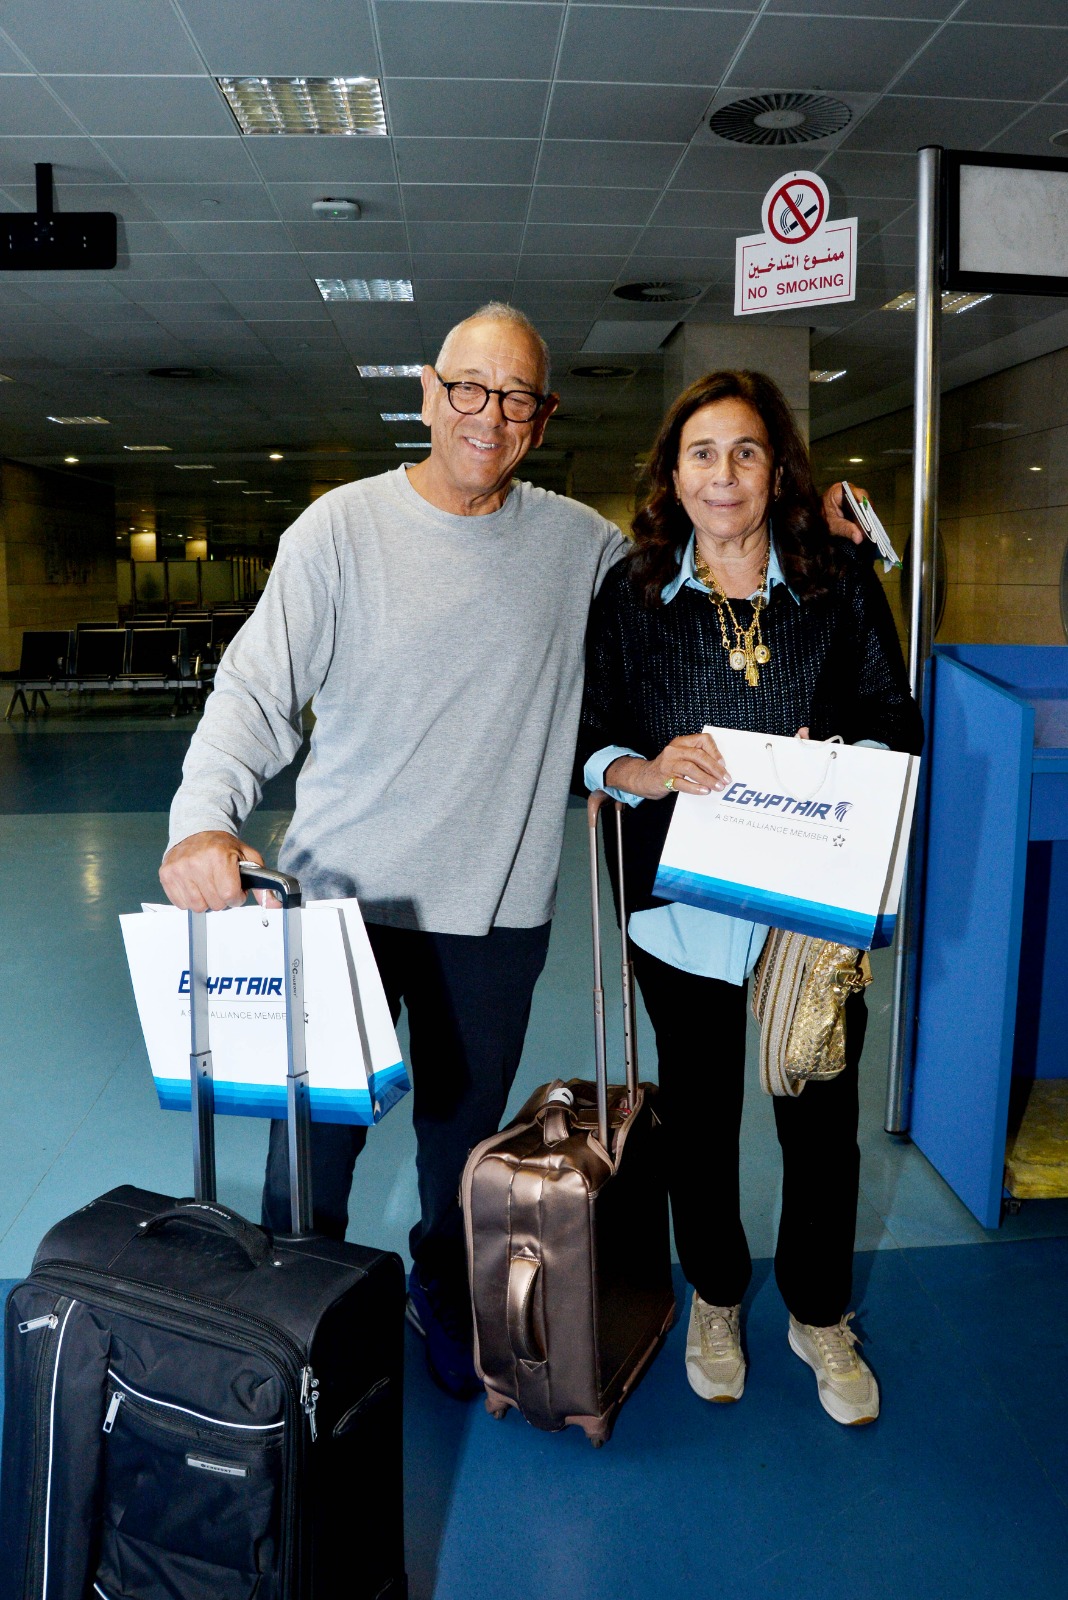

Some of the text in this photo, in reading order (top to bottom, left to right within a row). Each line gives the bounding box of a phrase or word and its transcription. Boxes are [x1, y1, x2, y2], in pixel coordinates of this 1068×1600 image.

[748, 248, 845, 279] ممنوع التدخين
[748, 273, 844, 300] NO SMOKING
[722, 782, 832, 820] EGYPTAIR
[722, 815, 745, 825] STAR
[746, 817, 788, 835] ALLIANCE
[790, 828, 829, 842] MEMBER
[178, 970, 283, 996] EYPTAIR
[210, 1011, 252, 1019] ALLIANCE
[254, 1012, 286, 1020] MEMBE
